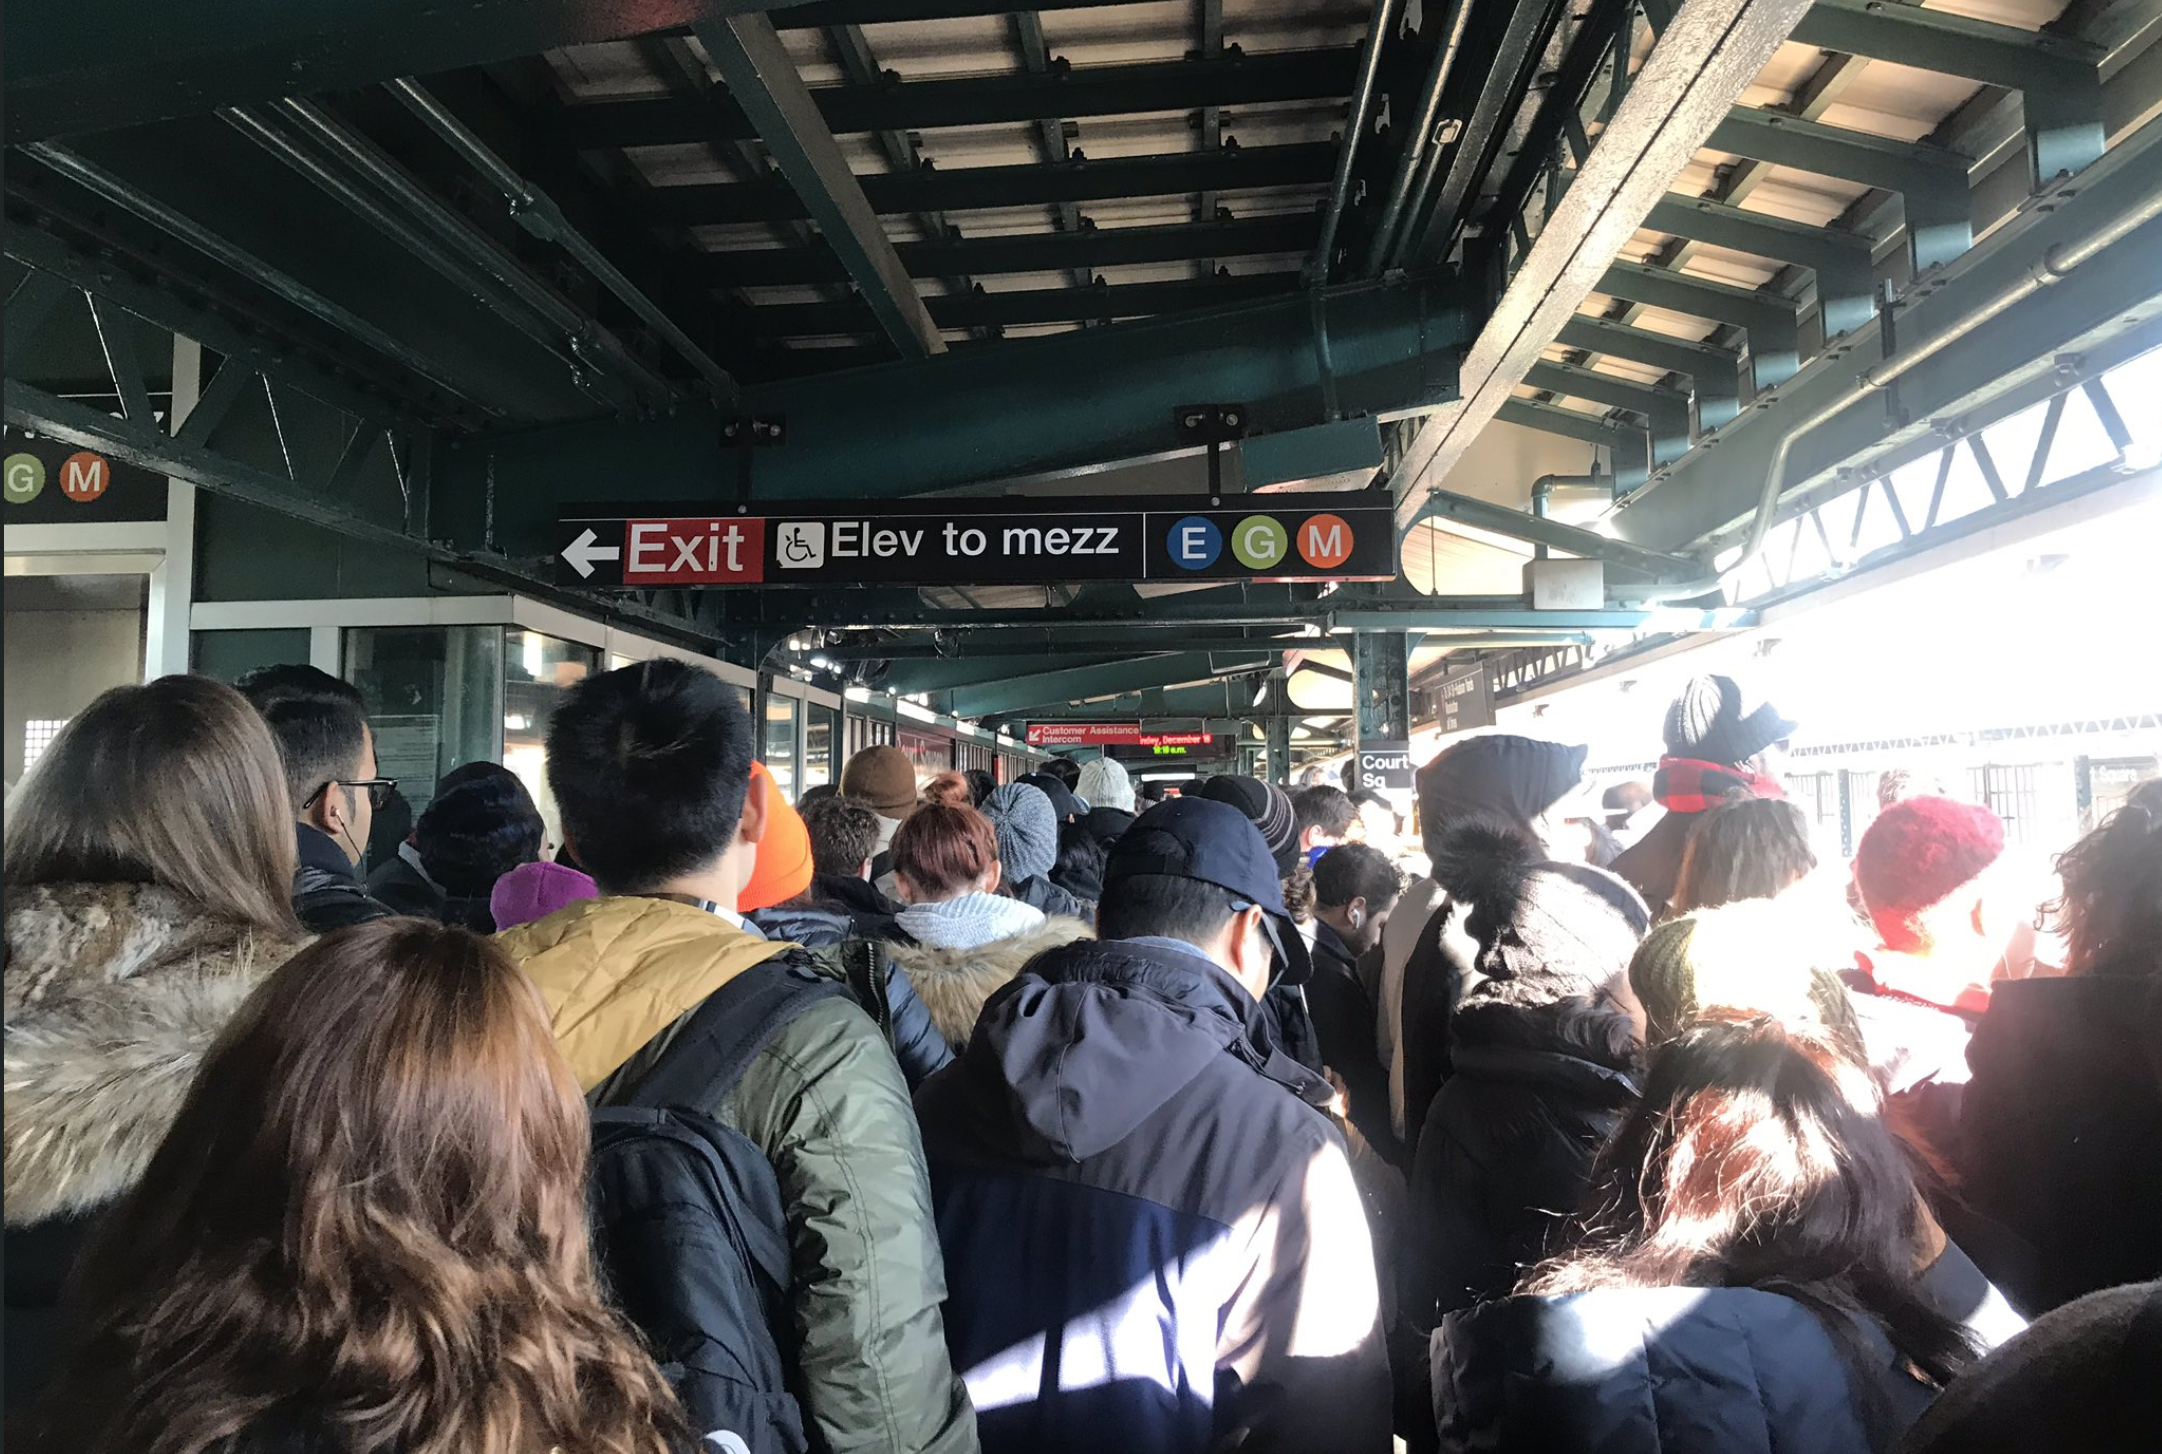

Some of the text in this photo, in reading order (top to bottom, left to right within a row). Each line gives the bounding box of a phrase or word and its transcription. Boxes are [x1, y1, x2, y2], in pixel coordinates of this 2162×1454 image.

[8, 460, 101, 492] G M
[628, 521, 1342, 573] Exit Elev to mezz E G M
[1042, 726, 1139, 735] Customer Assistance
[1042, 735, 1082, 743] Intercom
[1162, 734, 1201, 745] December
[1362, 754, 1409, 769] Court
